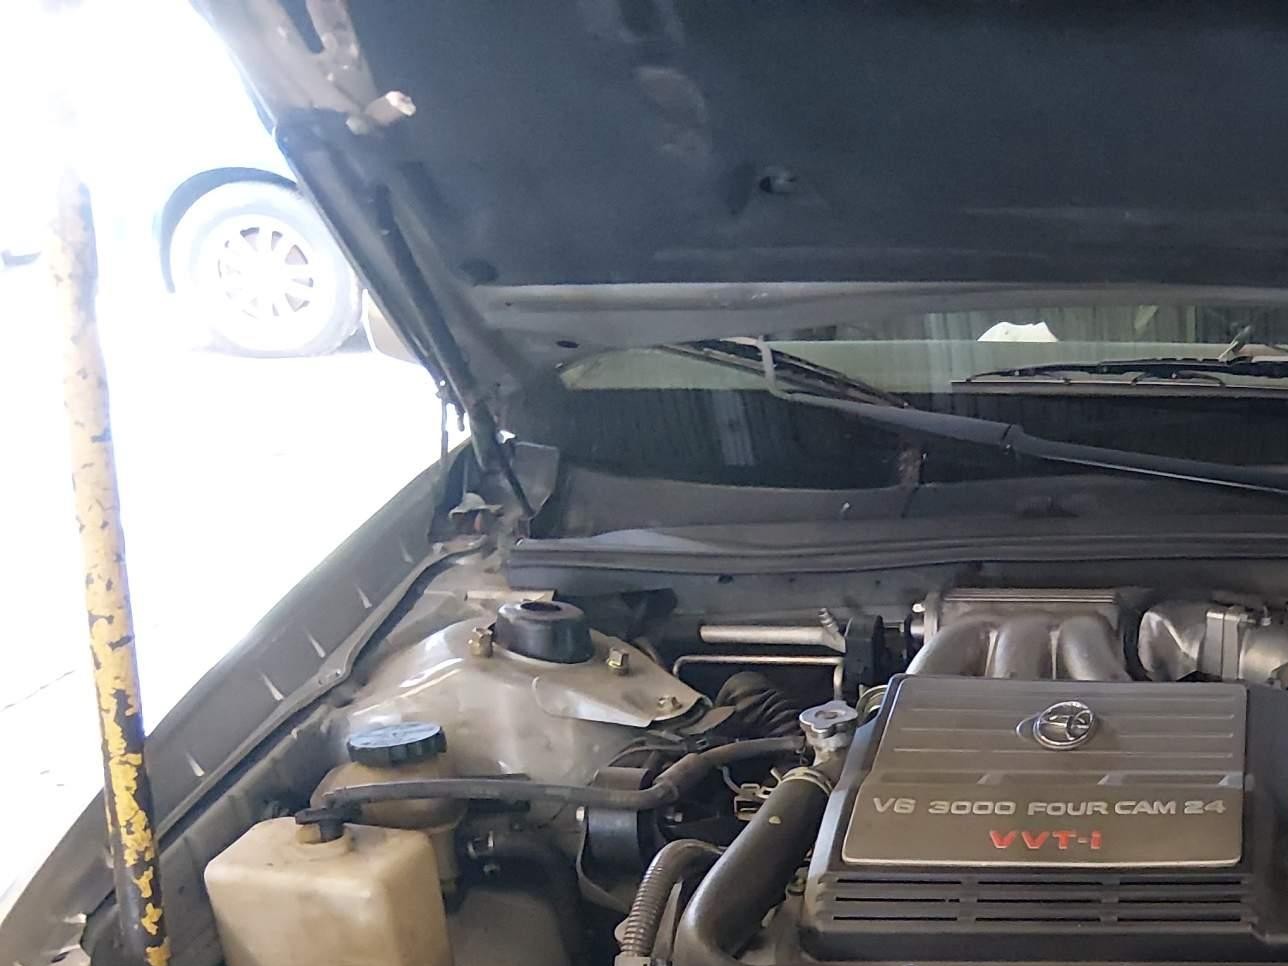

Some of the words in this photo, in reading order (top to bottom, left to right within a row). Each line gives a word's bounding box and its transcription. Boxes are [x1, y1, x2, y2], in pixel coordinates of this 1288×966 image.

[872, 797, 916, 814] V6
[928, 800, 1016, 815] 3000
[1027, 801, 1109, 816] FOUR
[1114, 800, 1176, 815] CAM
[1183, 799, 1226, 814] 24
